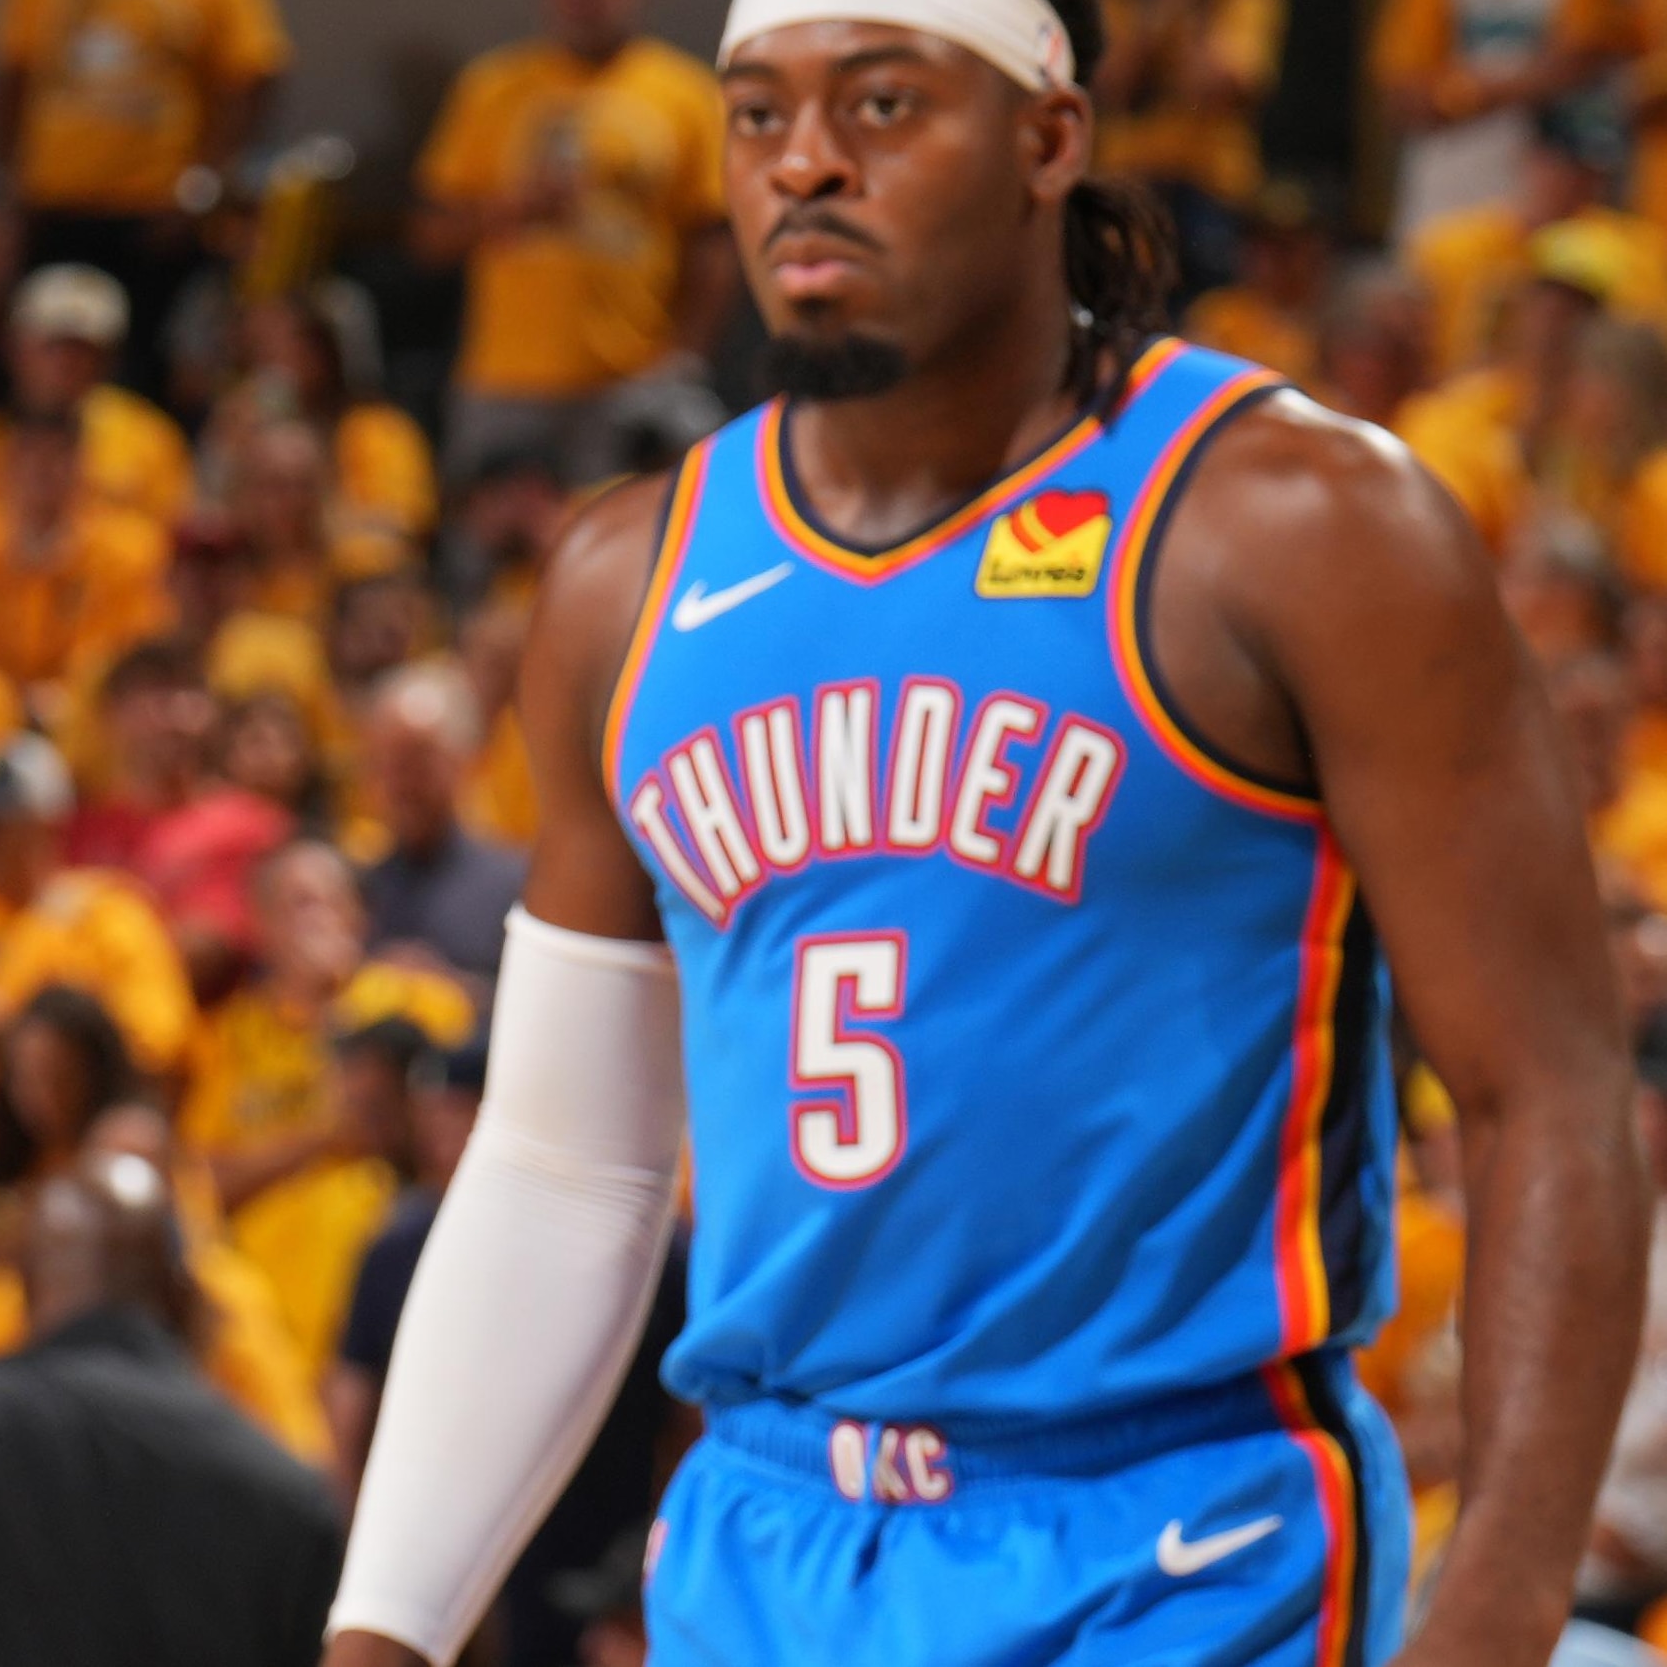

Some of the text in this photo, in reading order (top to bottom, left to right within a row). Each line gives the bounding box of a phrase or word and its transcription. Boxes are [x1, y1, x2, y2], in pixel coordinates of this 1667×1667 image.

[629, 674, 1127, 930] THUNDER
[789, 929, 908, 1191] 5
[828, 1418, 954, 1504] OKC
